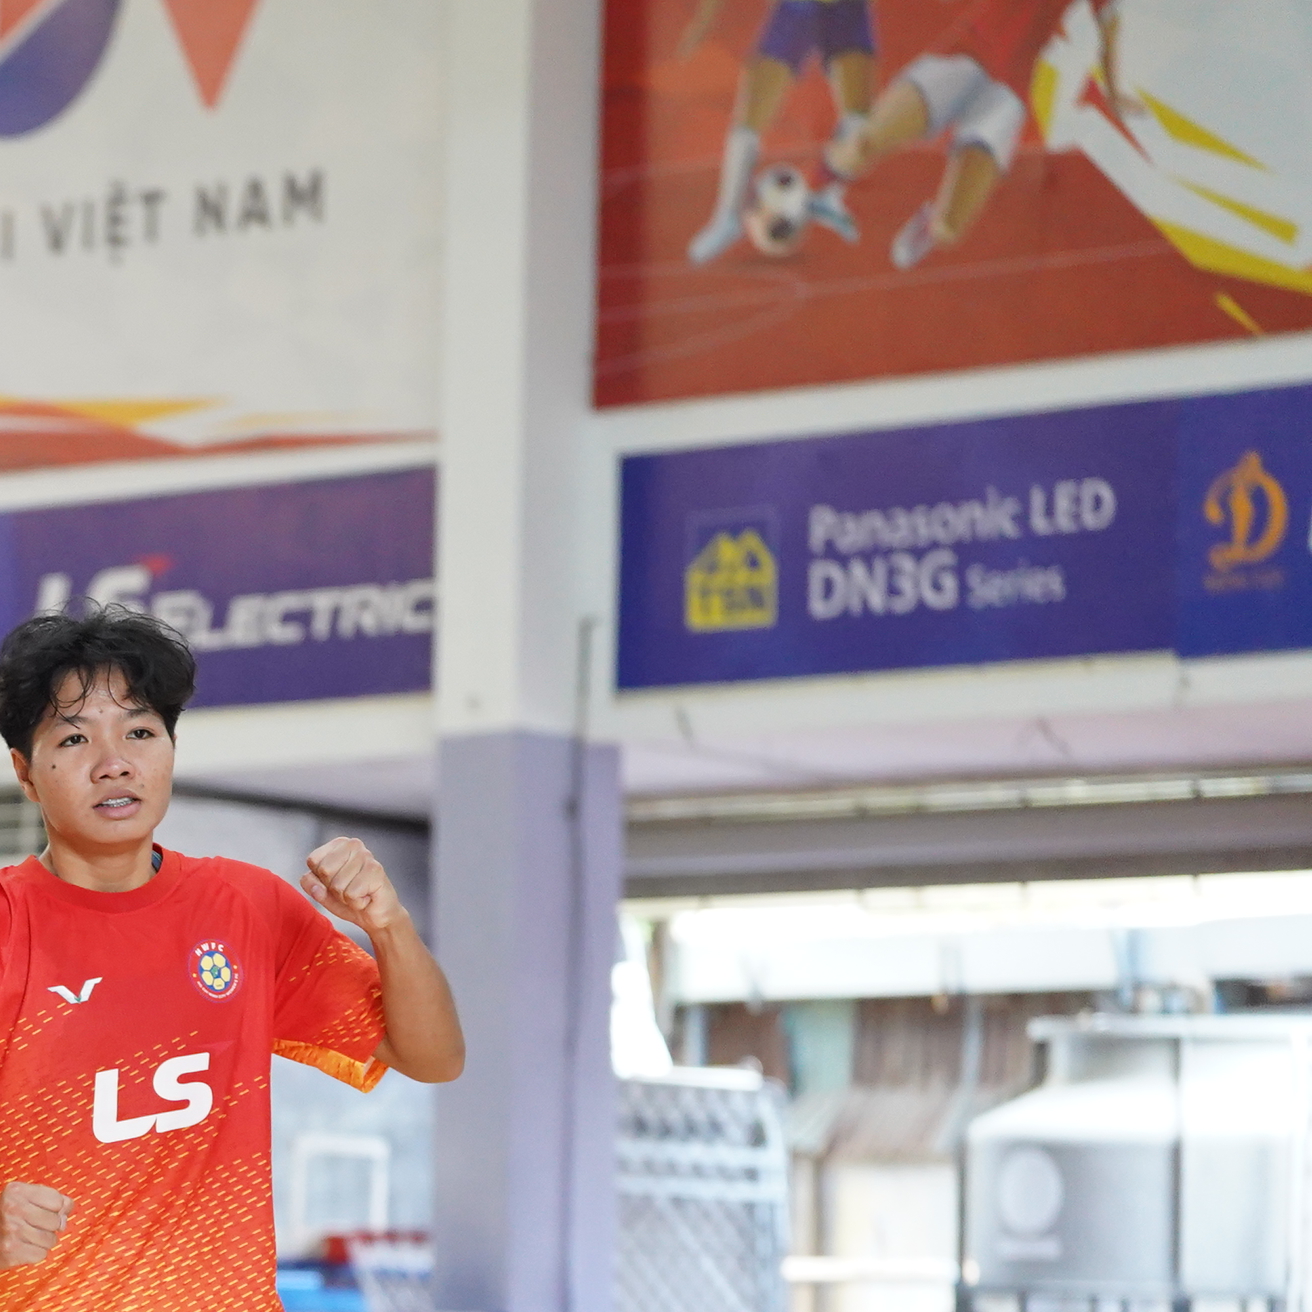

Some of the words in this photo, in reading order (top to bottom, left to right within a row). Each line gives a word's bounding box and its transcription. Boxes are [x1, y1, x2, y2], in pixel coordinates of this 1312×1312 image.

[39, 180, 168, 266] VIỆT
[191, 167, 327, 238] NAM
[807, 485, 1023, 555] Panasonic
[1029, 476, 1117, 537] LED
[808, 548, 960, 620] DN3G
[966, 561, 1066, 610] Series
[92, 1052, 214, 1144] LS
